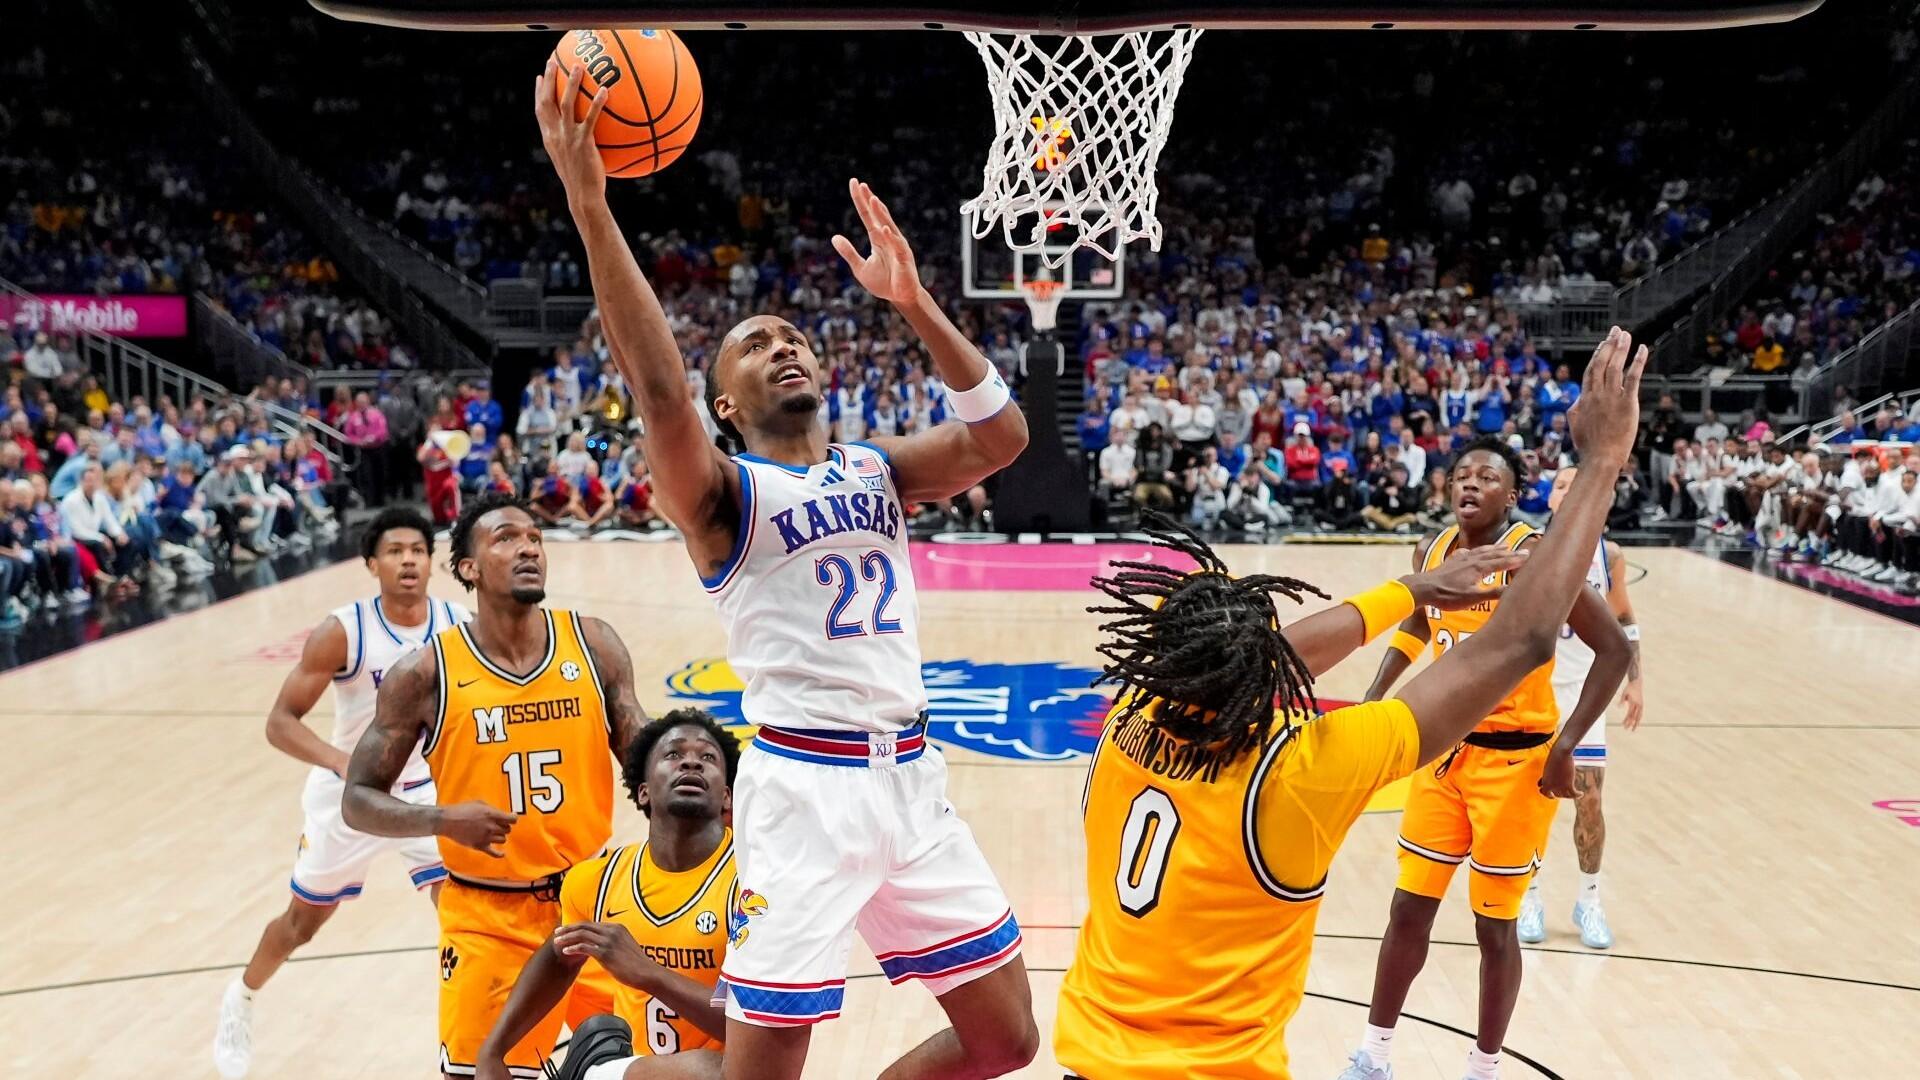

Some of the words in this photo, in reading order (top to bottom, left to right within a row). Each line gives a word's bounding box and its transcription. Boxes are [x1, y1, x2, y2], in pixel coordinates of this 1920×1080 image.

[769, 492, 899, 555] KANSAS
[814, 550, 904, 640] 22
[472, 697, 582, 744] MISSOURI
[875, 743, 892, 757] KU
[502, 749, 564, 815] 15
[1115, 784, 1182, 919] 0
[696, 910, 718, 934] SEC
[639, 944, 716, 969] SSOURI
[645, 996, 680, 1056] 6
